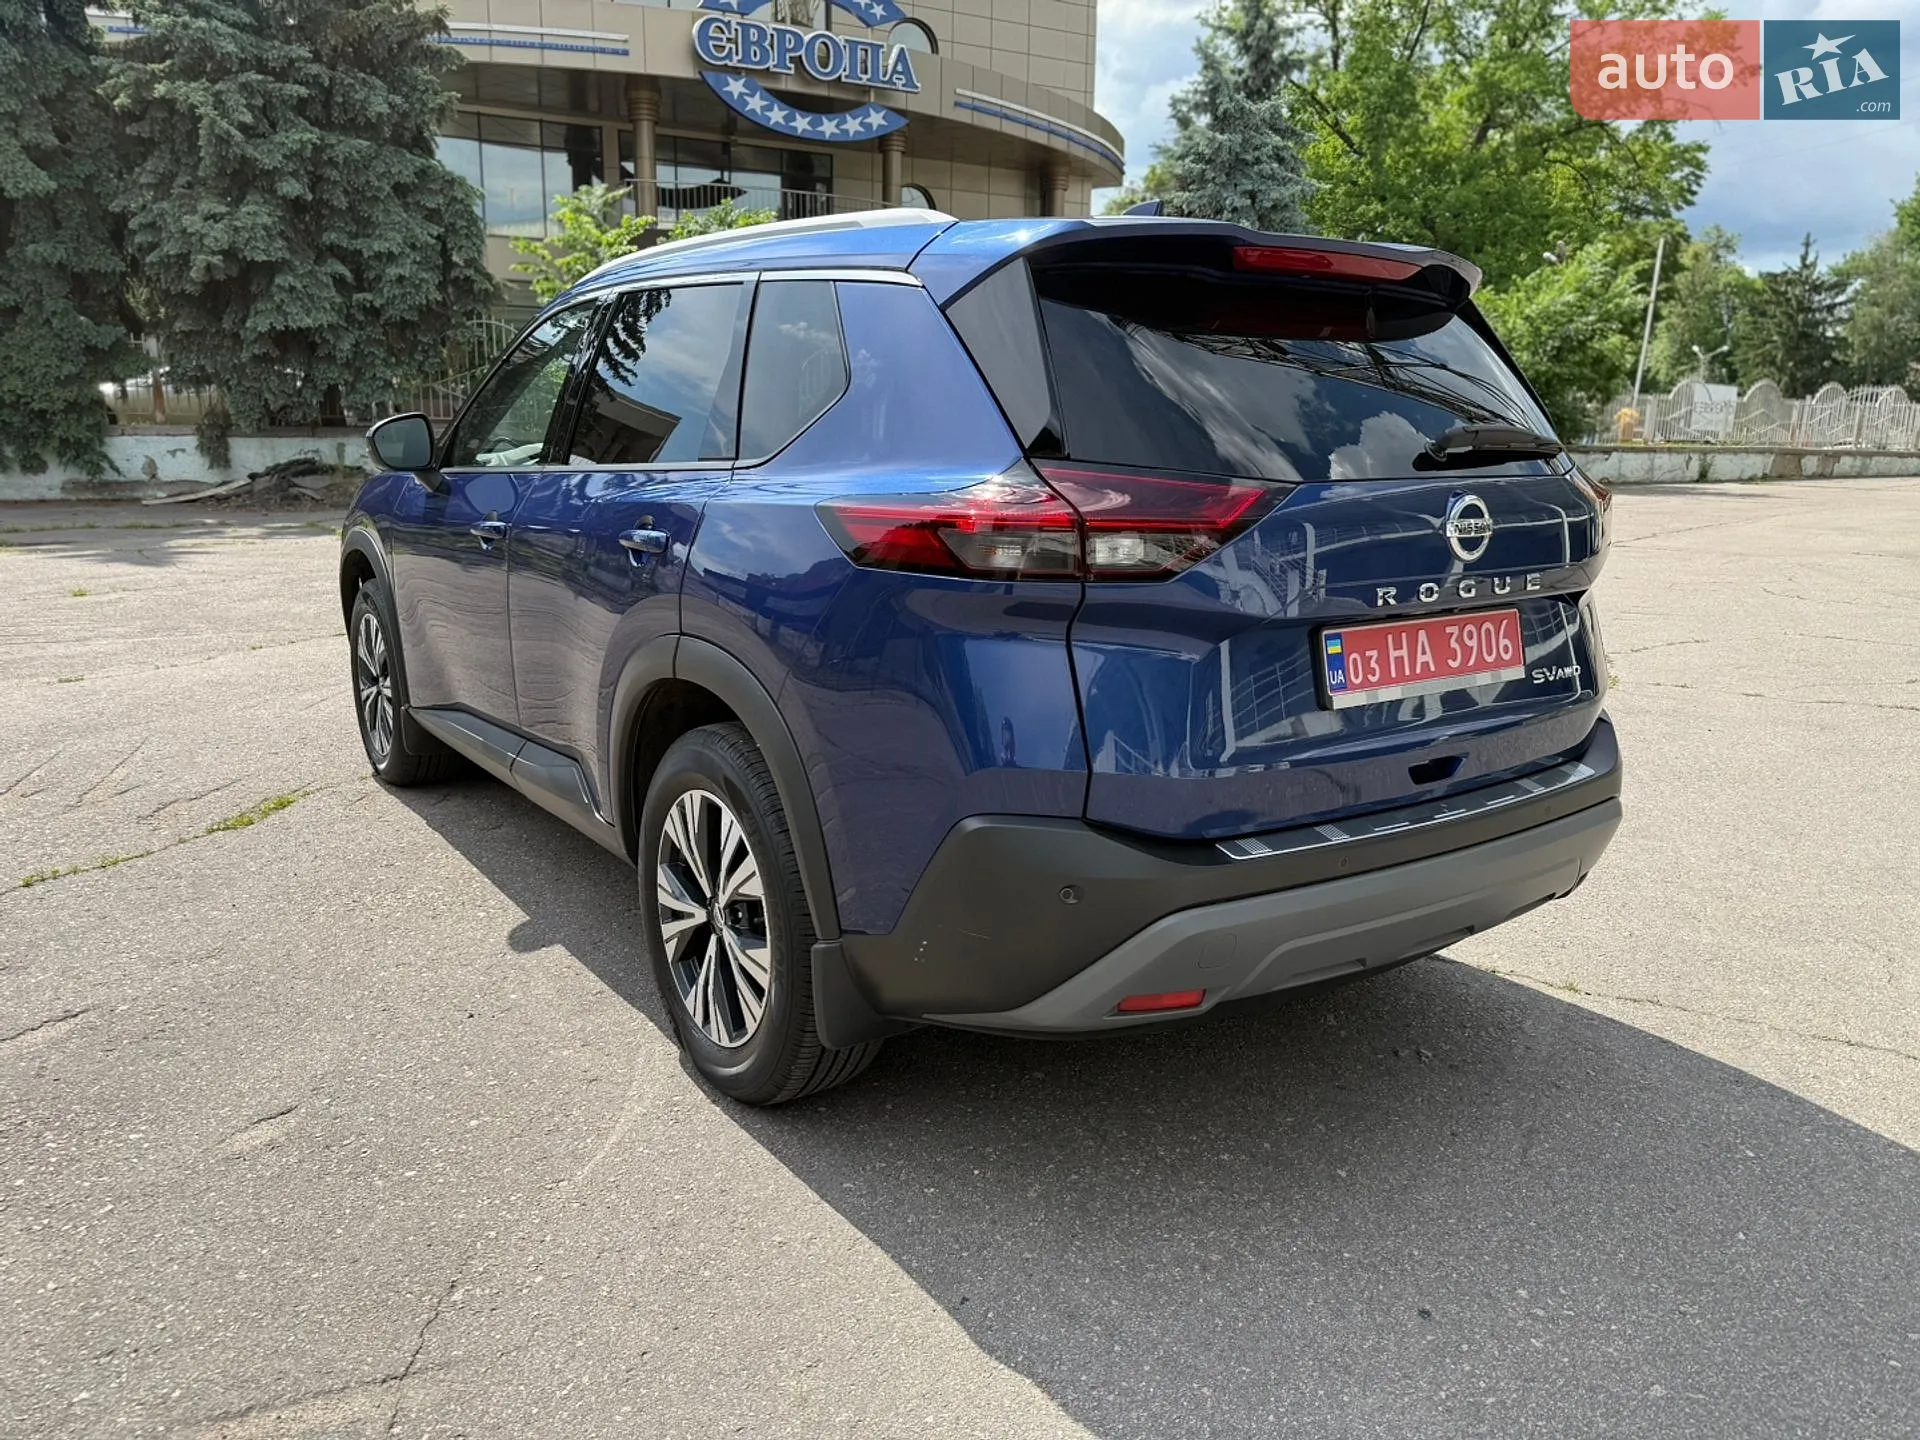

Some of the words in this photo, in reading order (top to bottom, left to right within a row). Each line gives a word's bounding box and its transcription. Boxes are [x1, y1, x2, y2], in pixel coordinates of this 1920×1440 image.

[692, 14, 920, 93] ЄВРОПА
[1376, 573, 1541, 607] ROGUE
[1330, 669, 1346, 685] UA
[1349, 650, 1381, 685] 03
[1446, 619, 1513, 668] 3906
